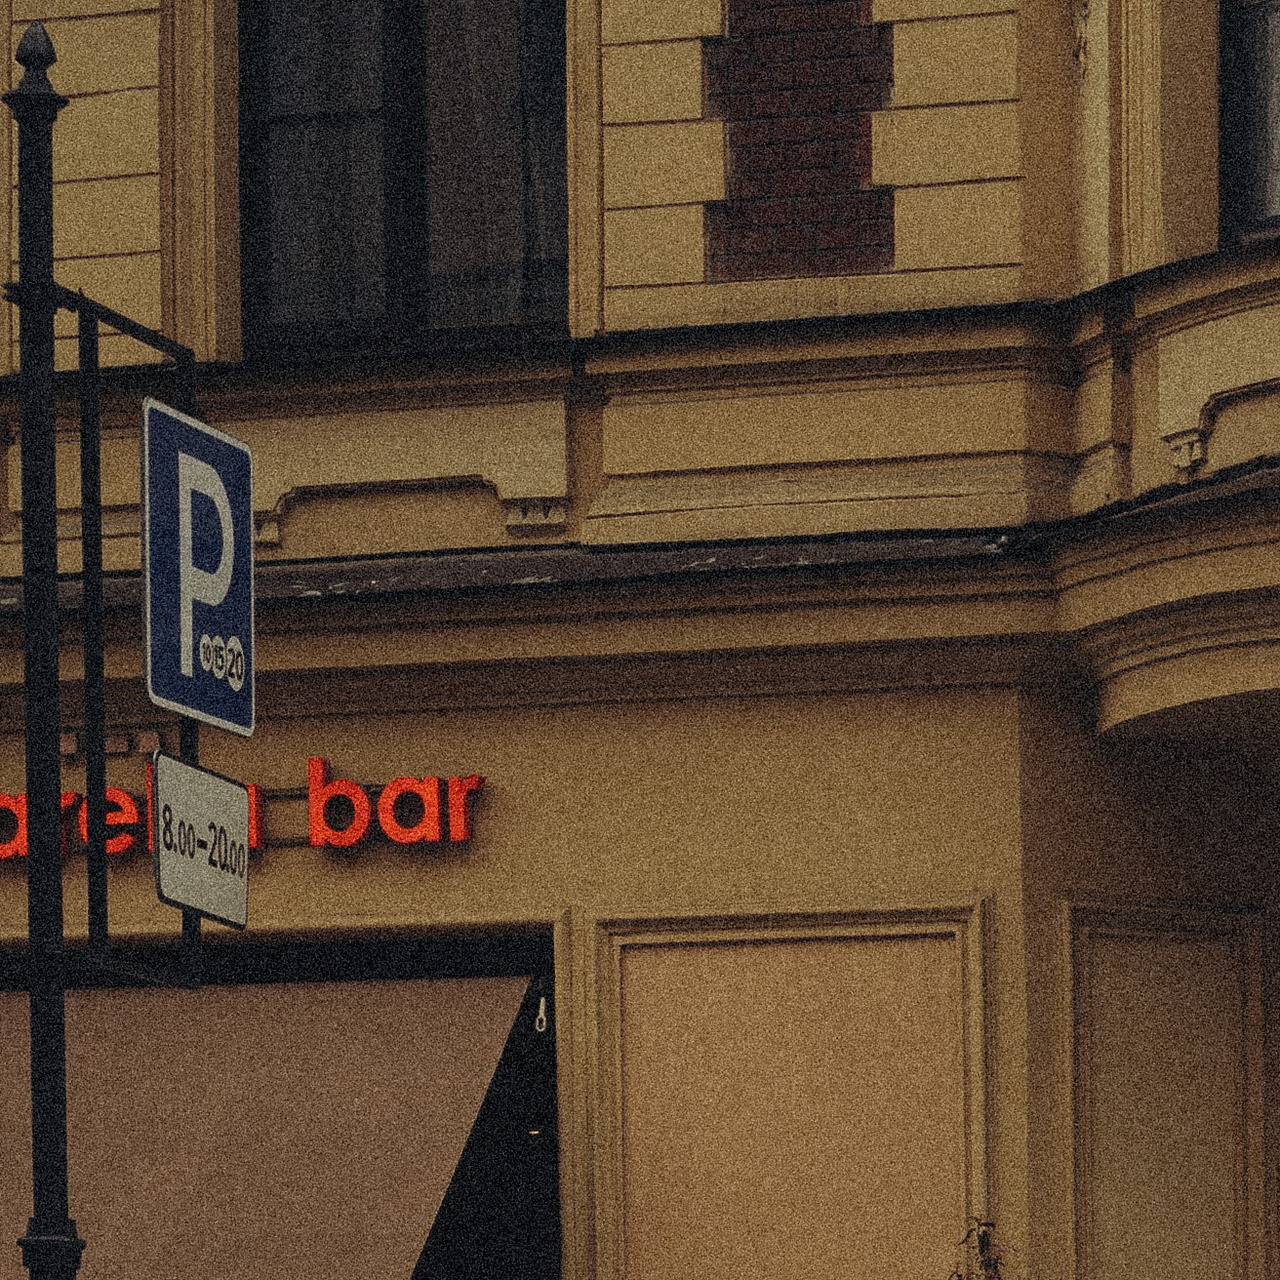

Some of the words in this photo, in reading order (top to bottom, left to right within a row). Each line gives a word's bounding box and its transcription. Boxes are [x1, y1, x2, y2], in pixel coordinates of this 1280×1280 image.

[178, 452, 234, 676] P
[228, 648, 243, 680] 20
[162, 804, 246, 878] 8.00-20.00
[308, 757, 486, 847] bar
